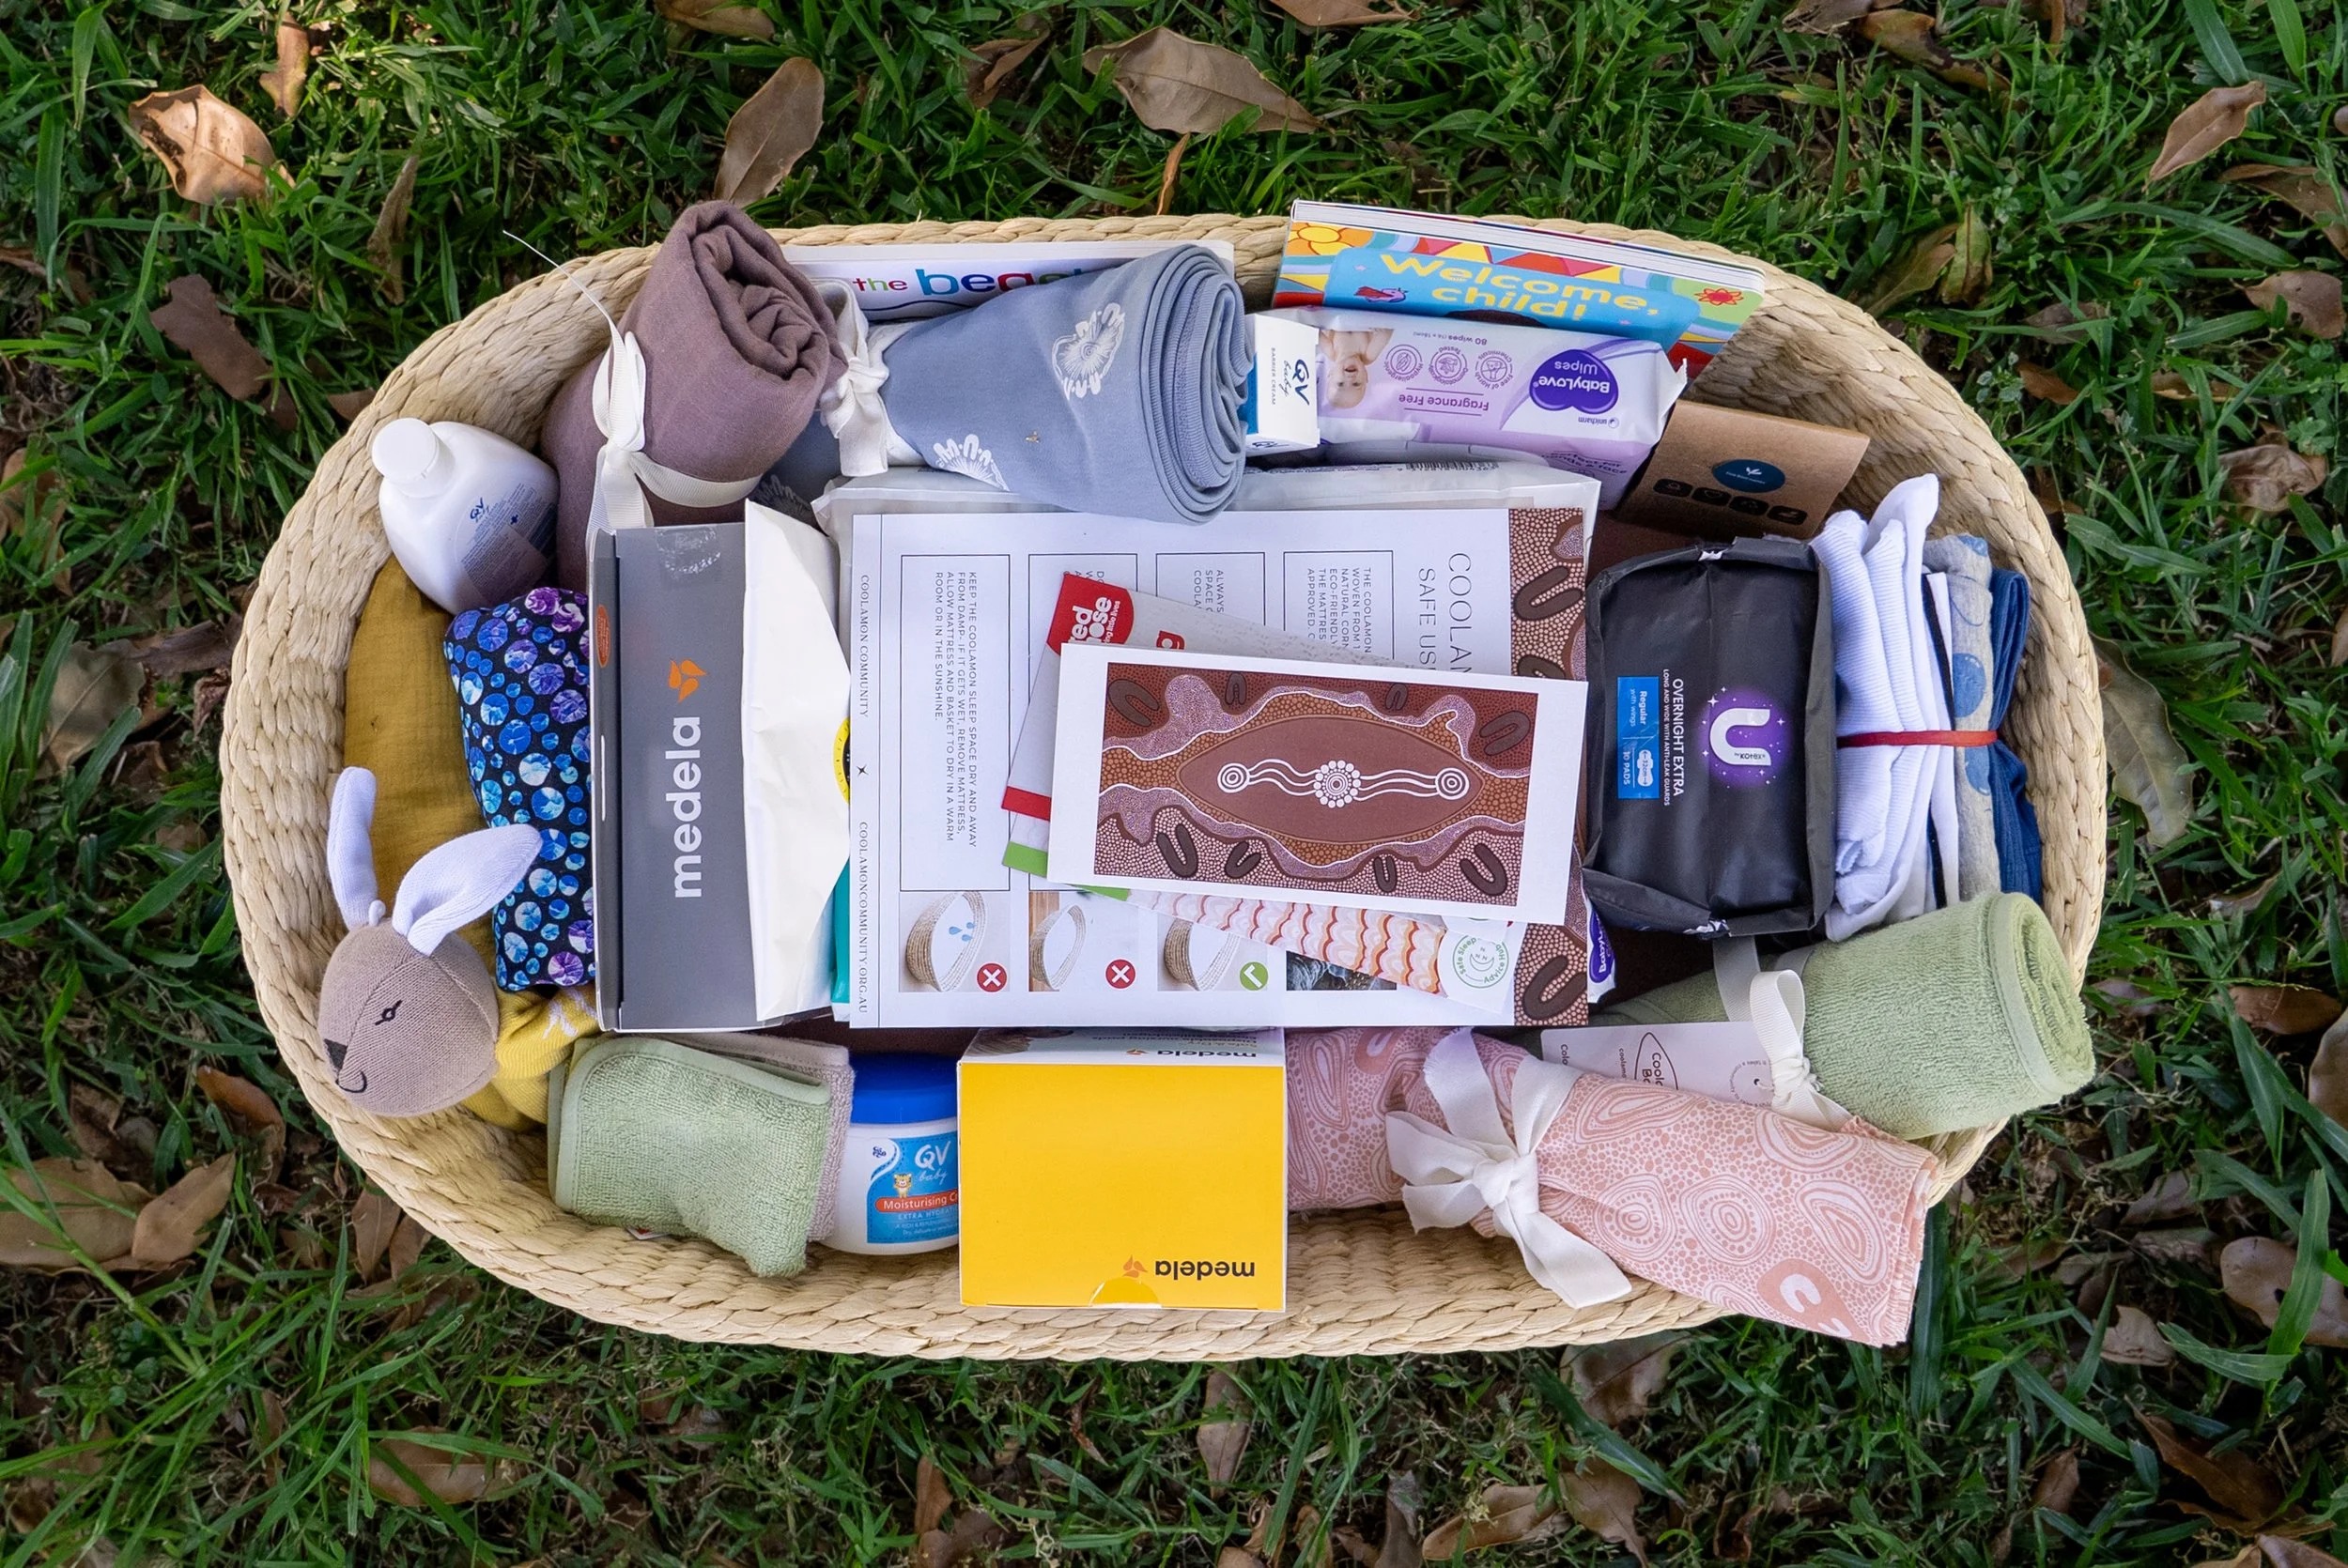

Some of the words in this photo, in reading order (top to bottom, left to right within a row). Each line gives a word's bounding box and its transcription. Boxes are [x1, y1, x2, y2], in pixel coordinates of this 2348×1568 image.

[853, 277, 908, 291] the
[1379, 254, 1659, 316] Welcome,
[1431, 286, 1587, 321] child!
[1438, 346, 1461, 354] Tested
[1278, 360, 1292, 397] baby
[1554, 361, 1599, 376] Wipes
[1291, 359, 1310, 406] QV
[1538, 376, 1611, 393] BabyLove
[1398, 393, 1425, 407] Free
[1427, 396, 1490, 411] Fragrance
[1578, 416, 1608, 425] unicharm
[471, 497, 484, 519] QV
[935, 572, 943, 604] ROOM
[957, 572, 965, 602] FROM
[968, 572, 977, 599] KEEP
[1318, 568, 1326, 588] THE
[946, 571, 954, 609] ALLOW
[1418, 568, 1437, 626] SAFE
[859, 575, 869, 642] COOLAMON
[935, 607, 943, 623] OR
[968, 602, 977, 622] THE
[1111, 600, 1121, 617] lives
[935, 625, 943, 637] IN
[957, 606, 965, 640] DAMP-
[935, 639, 943, 660] THE
[946, 612, 954, 667] MATTRESS
[957, 644, 965, 653] IF
[957, 656, 965, 666] IT
[968, 624, 977, 687] COOLAMON
[859, 645, 869, 718] COMMUNITY
[935, 663, 943, 721] SUNSHINE.
[946, 669, 954, 692] AND
[957, 669, 965, 696] GETS
[968, 690, 977, 724] SLEEP
[1630, 688, 1638, 704] with
[946, 697, 954, 736] BASKET
[957, 699, 965, 726] WET,
[1629, 705, 1637, 727] wings
[1638, 691, 1648, 725] Regular
[1673, 678, 1685, 754] OVERNIGHT
[946, 740, 954, 754] TO
[957, 729, 965, 774] REMOVE
[968, 727, 977, 761] SPACE
[946, 757, 954, 779] DRY
[968, 765, 977, 786] DRY
[1672, 755, 1685, 796] EXTRA
[946, 782, 954, 793] IN
[665, 716, 703, 898] medela
[946, 796, 954, 805] A
[957, 776, 965, 835] MATTRESS,
[968, 790, 977, 812] AND
[946, 807, 954, 842] WARM
[968, 815, 977, 848] AWAY
[858, 822, 868, 1013] COOLAMONCOMMUNITY.ORG.AU
[1457, 937, 1477, 956] Sleep
[1483, 961, 1506, 984] Advice
[1156, 1050, 1257, 1058] medela
[914, 1140, 951, 1171] QV
[918, 1168, 949, 1186] baby
[883, 1196, 948, 1210] Moisturising
[1154, 1260, 1256, 1281] medela
